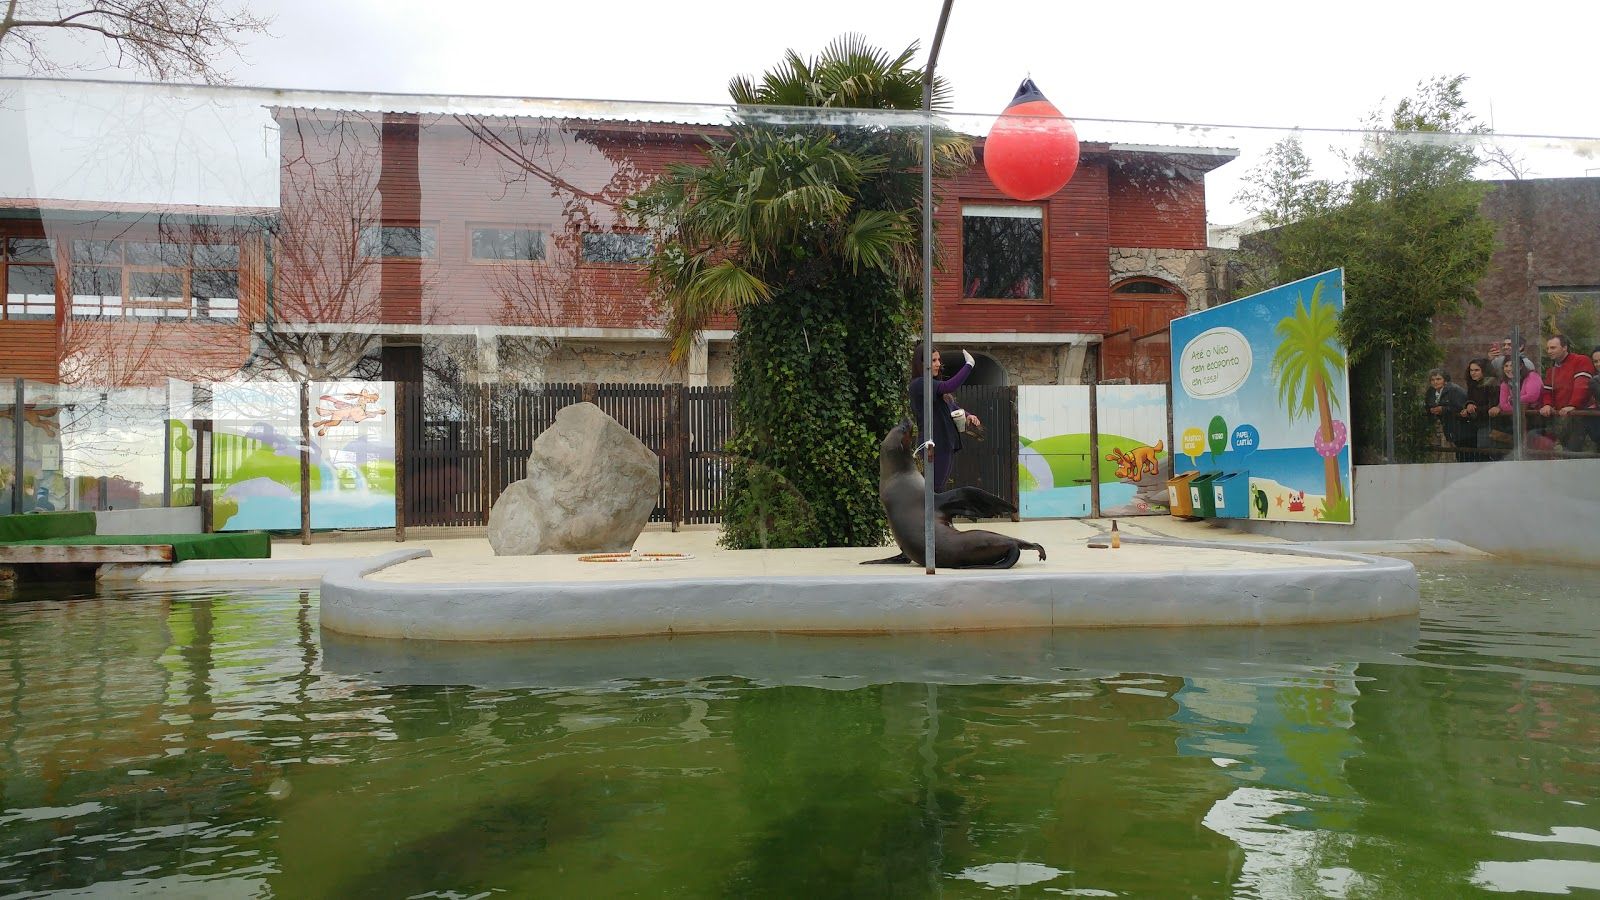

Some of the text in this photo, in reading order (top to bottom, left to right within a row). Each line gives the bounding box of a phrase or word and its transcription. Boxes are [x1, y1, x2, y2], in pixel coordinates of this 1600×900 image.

[1191, 348, 1204, 360] Até
[1213, 345, 1229, 355] Nico
[1191, 357, 1240, 373] tem ecoponto
[1192, 378, 1202, 386] em
